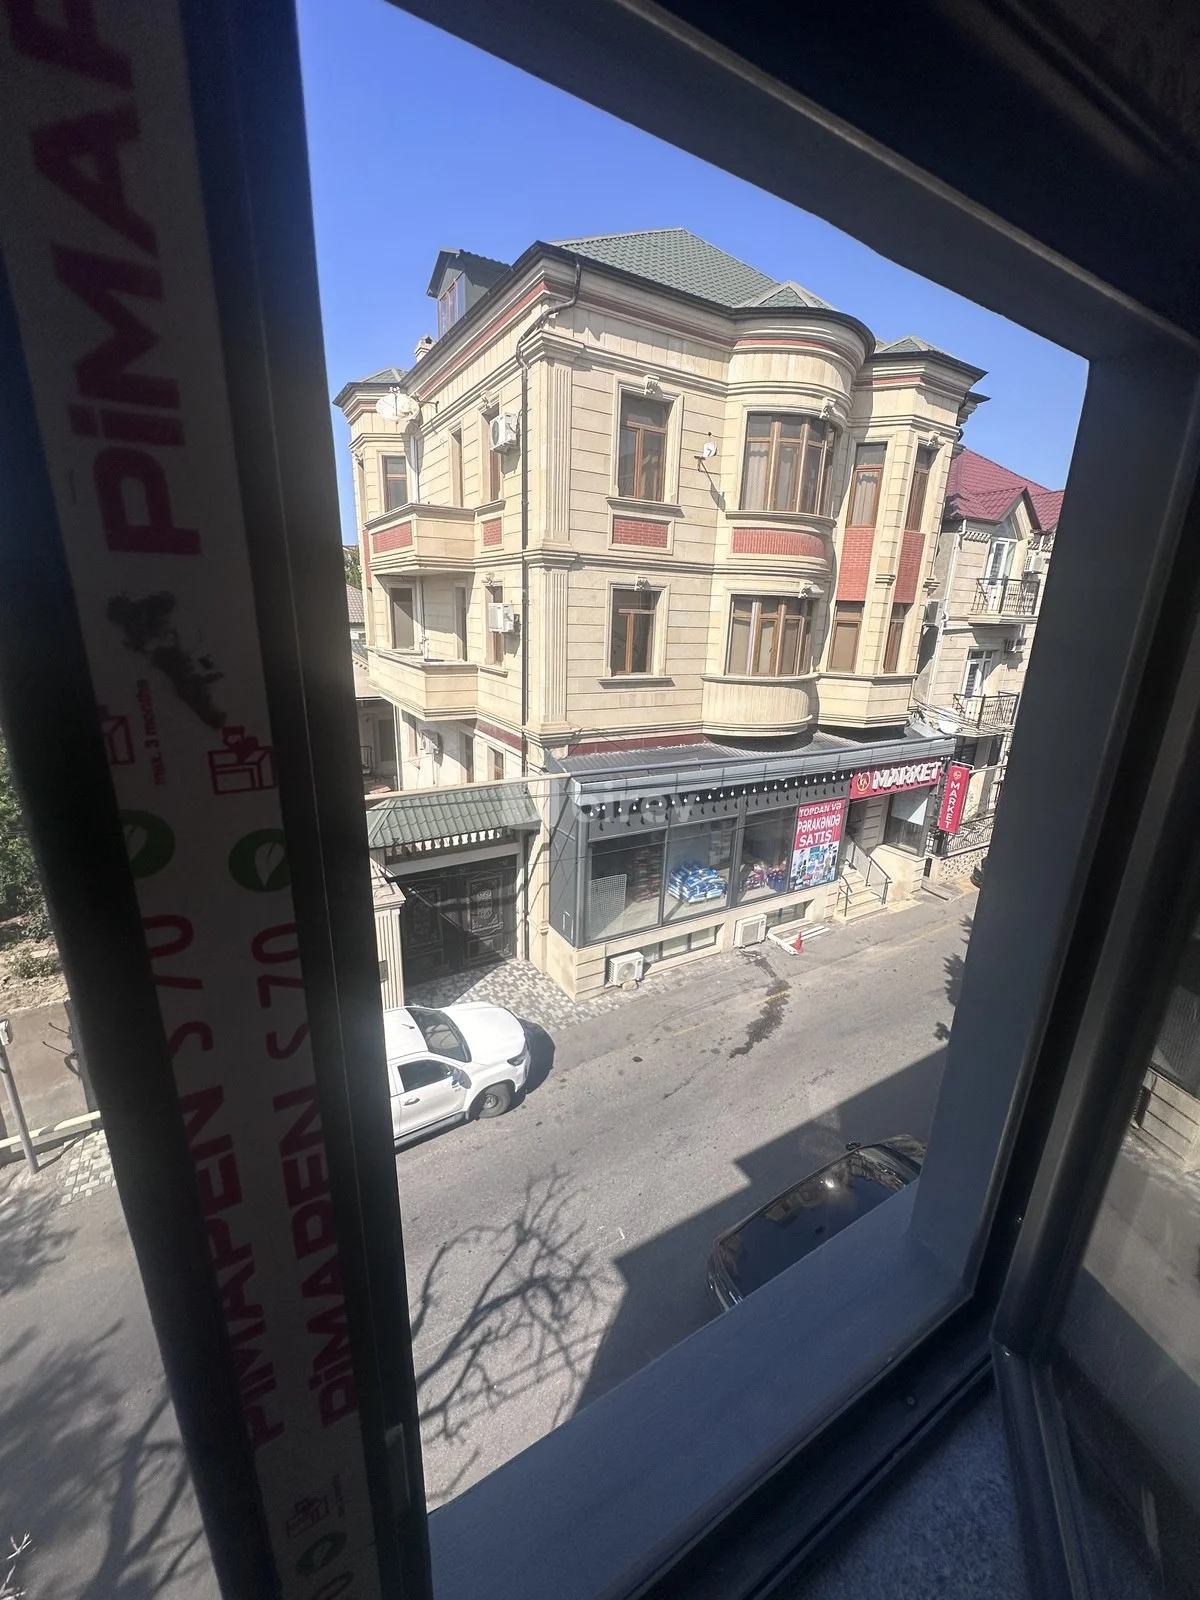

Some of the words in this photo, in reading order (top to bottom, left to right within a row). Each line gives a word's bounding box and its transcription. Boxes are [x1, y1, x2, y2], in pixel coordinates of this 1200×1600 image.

[135, 678, 157, 736] months
[144, 739, 159, 749] 3
[150, 752, 167, 786] max.
[872, 761, 943, 790] MARKET
[799, 805, 831, 818] TOPDAN
[944, 781, 960, 829] MARKET
[799, 829, 833, 847] SATIŞ
